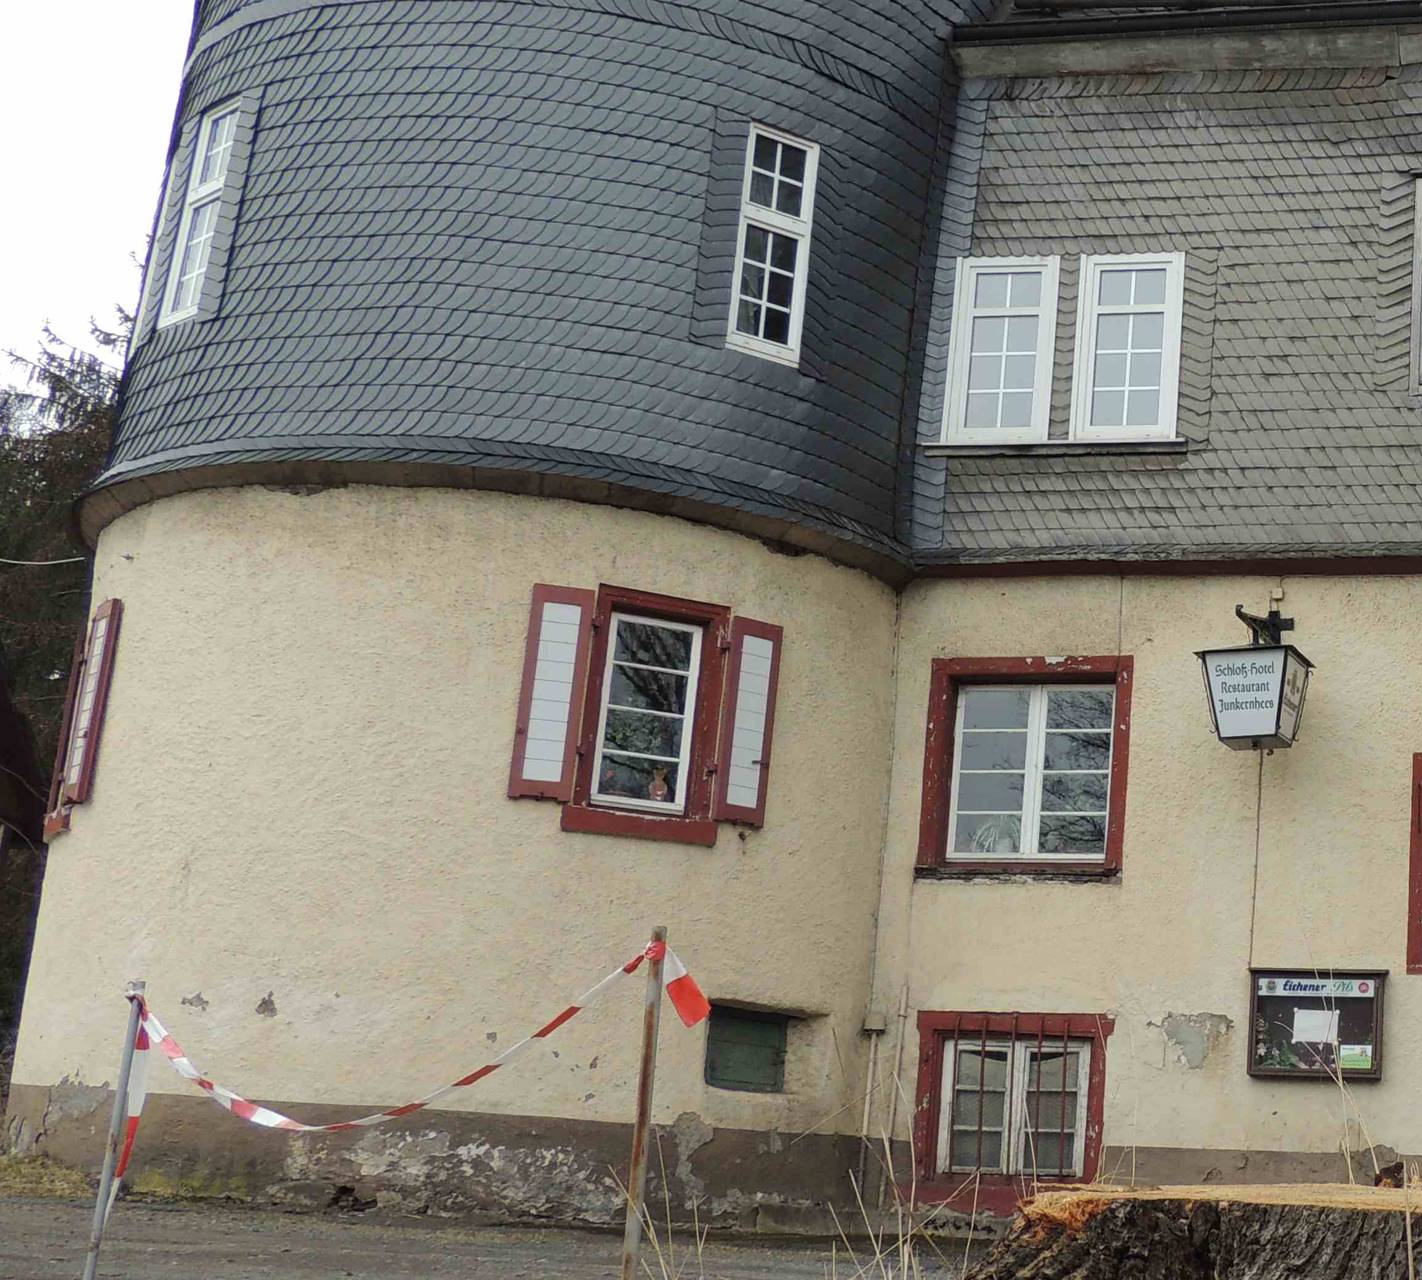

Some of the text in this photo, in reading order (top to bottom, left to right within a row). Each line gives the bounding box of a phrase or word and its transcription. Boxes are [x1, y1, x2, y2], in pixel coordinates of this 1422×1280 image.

[1221, 681, 1270, 694] Restaurant
[1219, 697, 1274, 713] Junkernhees
[1283, 980, 1354, 993] Eichener Pils
